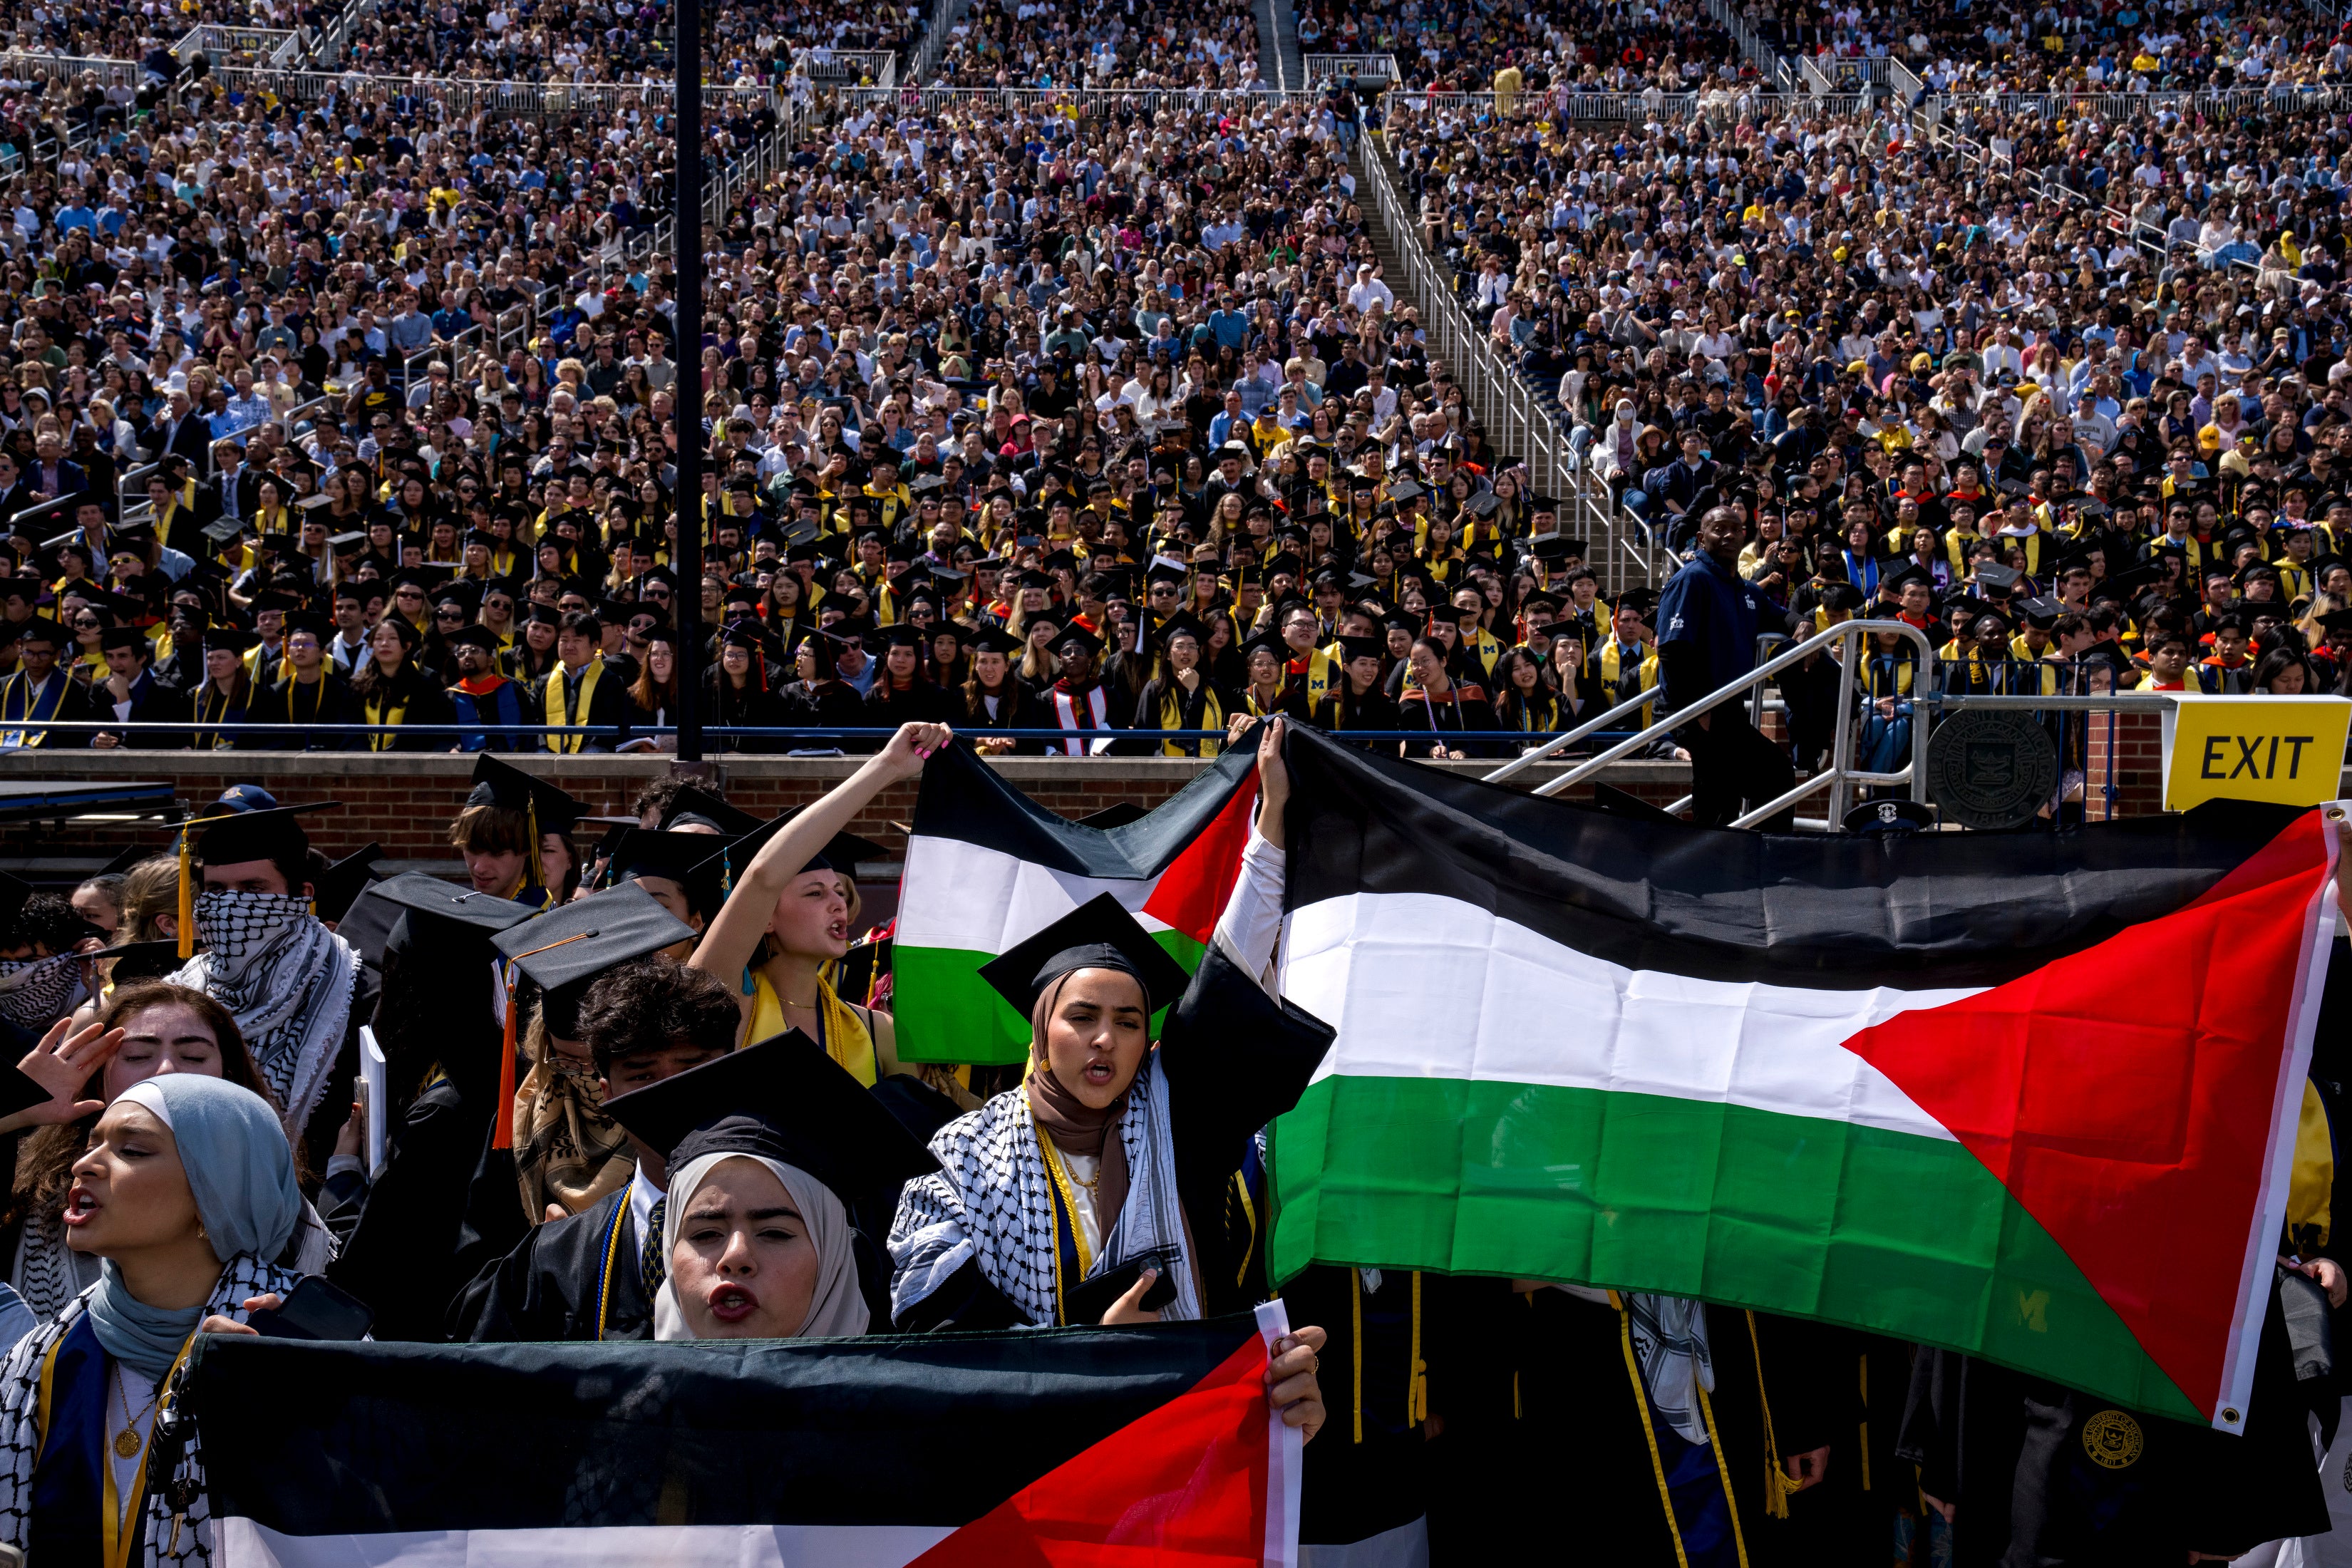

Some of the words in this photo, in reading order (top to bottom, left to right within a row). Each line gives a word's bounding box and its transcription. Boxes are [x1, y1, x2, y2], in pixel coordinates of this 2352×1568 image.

[1482, 645, 1495, 654] M
[520, 680, 532, 690] M
[1311, 680, 1324, 689] M
[1604, 680, 1616, 689] M
[1929, 760, 1946, 790] THE
[2021, 723, 2053, 796] MICHIGAN
[2201, 736, 2314, 779] EXIT
[1972, 811, 2008, 825] 1817
[2292, 1223, 2321, 1252] M
[2018, 1290, 2051, 1332] M
[2087, 1413, 2120, 1433] UNIVERSITY
[2120, 1416, 2130, 1425] OF
[2128, 1423, 2140, 1459] MICHIGAN
[2100, 1457, 2117, 1465] 1817
